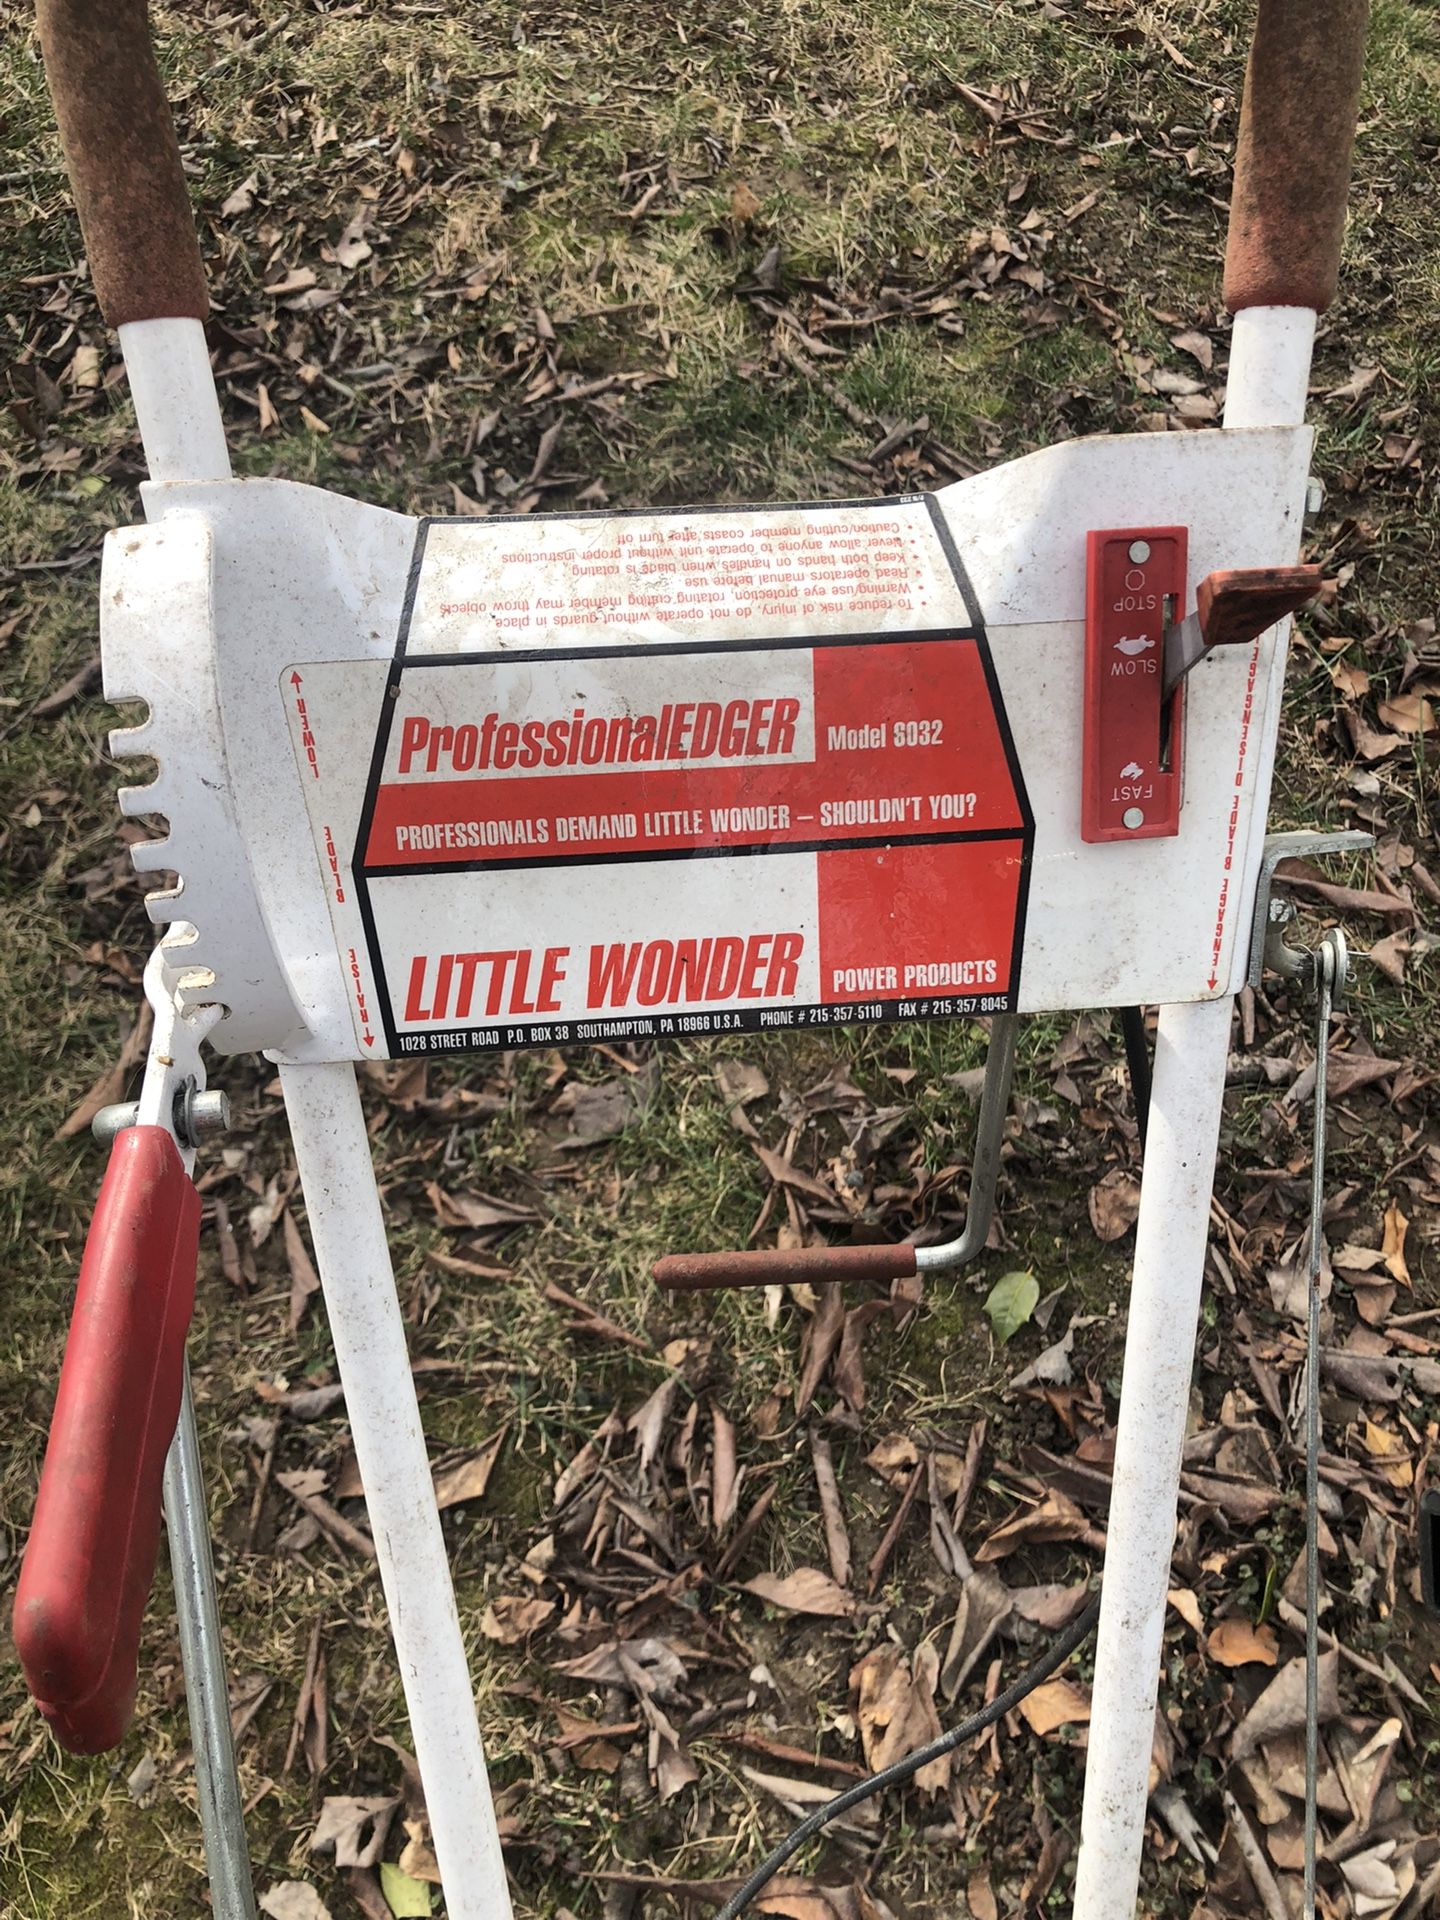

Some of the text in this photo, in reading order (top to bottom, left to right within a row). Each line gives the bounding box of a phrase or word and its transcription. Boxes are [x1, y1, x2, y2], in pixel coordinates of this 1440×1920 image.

[616, 522, 900, 545] Caution/cutting member coasts after turn off
[502, 537, 905, 563] Never allow anyone to operate unit without proper instructions
[572, 552, 906, 576] Keep both hands on handles when blade is rotating
[685, 567, 908, 587] Read operators manual before use
[804, 585, 826, 596] eye
[831, 582, 911, 595] Warning/use
[535, 598, 564, 610] may
[569, 596, 622, 610] member
[628, 593, 672, 607] cutting
[677, 591, 725, 603] rotating
[1113, 595, 1156, 612] STOP
[440, 601, 487, 615] objects
[493, 600, 530, 612] throw
[802, 602, 815, 614] of
[820, 601, 843, 612] risk
[849, 599, 892, 612] reduce
[897, 599, 914, 610] To
[603, 611, 650, 624] without
[656, 608, 704, 622] operate
[710, 607, 731, 618] not
[736, 607, 752, 618] do
[495, 615, 530, 628] place
[536, 615, 547, 625] in
[553, 613, 598, 627] guards
[1111, 659, 1157, 676] SLOW
[828, 723, 887, 751] Model
[1111, 785, 1153, 801] FAST
[395, 818, 549, 850] PROFESSIONALS
[556, 813, 637, 842] DEMAND
[644, 809, 704, 837] LITTLE
[710, 804, 790, 833] WONDER
[819, 796, 922, 827] SHOULDN'T
[928, 793, 977, 820] YOU?
[403, 932, 804, 1023] LITTLE WONDER
[833, 959, 997, 993] POWER PRODUCTS
[399, 996, 1008, 1051] 1028 STREET ROAD P.O. BOX 38 SOUTHAMPTON, PA 18966 U.S.A. PHONE # 215-357-5110 FAX # 215-357-8045
